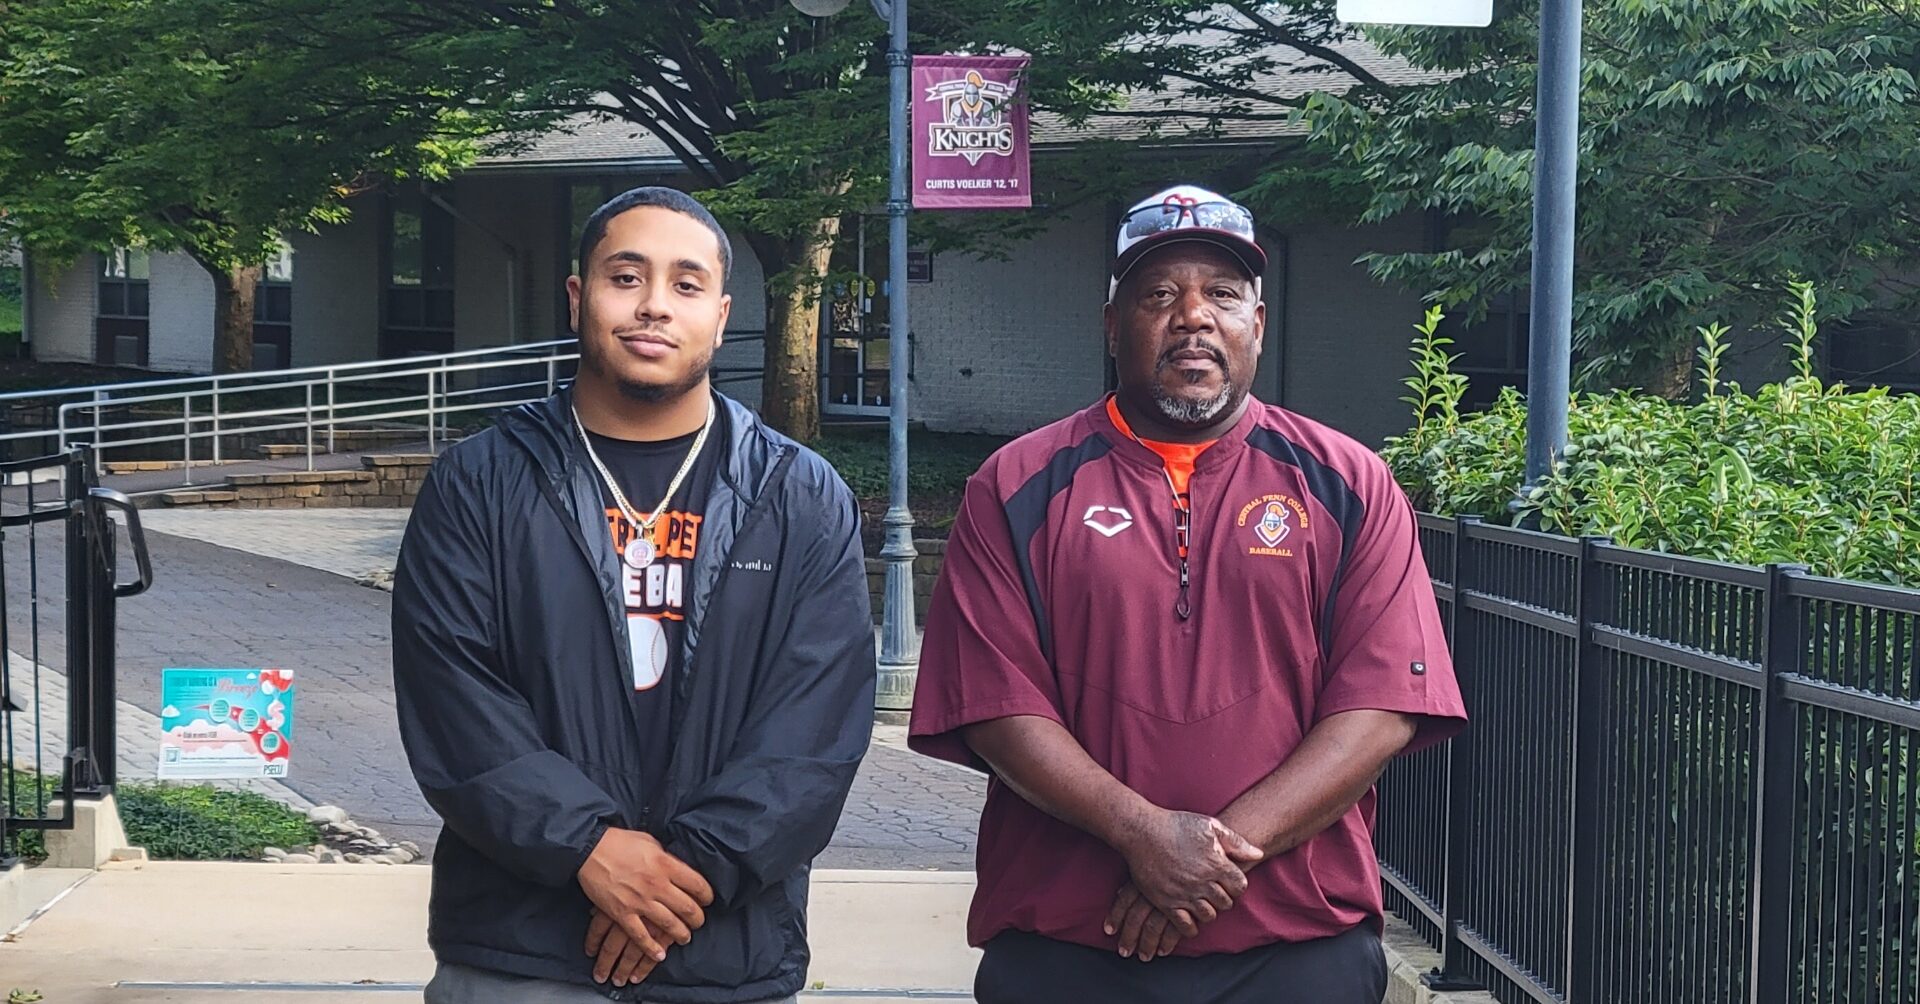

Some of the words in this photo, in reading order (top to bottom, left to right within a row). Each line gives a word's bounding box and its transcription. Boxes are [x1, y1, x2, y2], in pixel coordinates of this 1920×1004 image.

[934, 128, 1012, 151] KNIGHTS
[925, 179, 955, 189] CURTIS
[956, 179, 992, 189] VOELKER
[1238, 498, 1262, 527] CENTRAL
[1262, 494, 1287, 502] PENN
[1287, 498, 1308, 529] COLLEGE
[1249, 547, 1293, 557] BASEBALL
